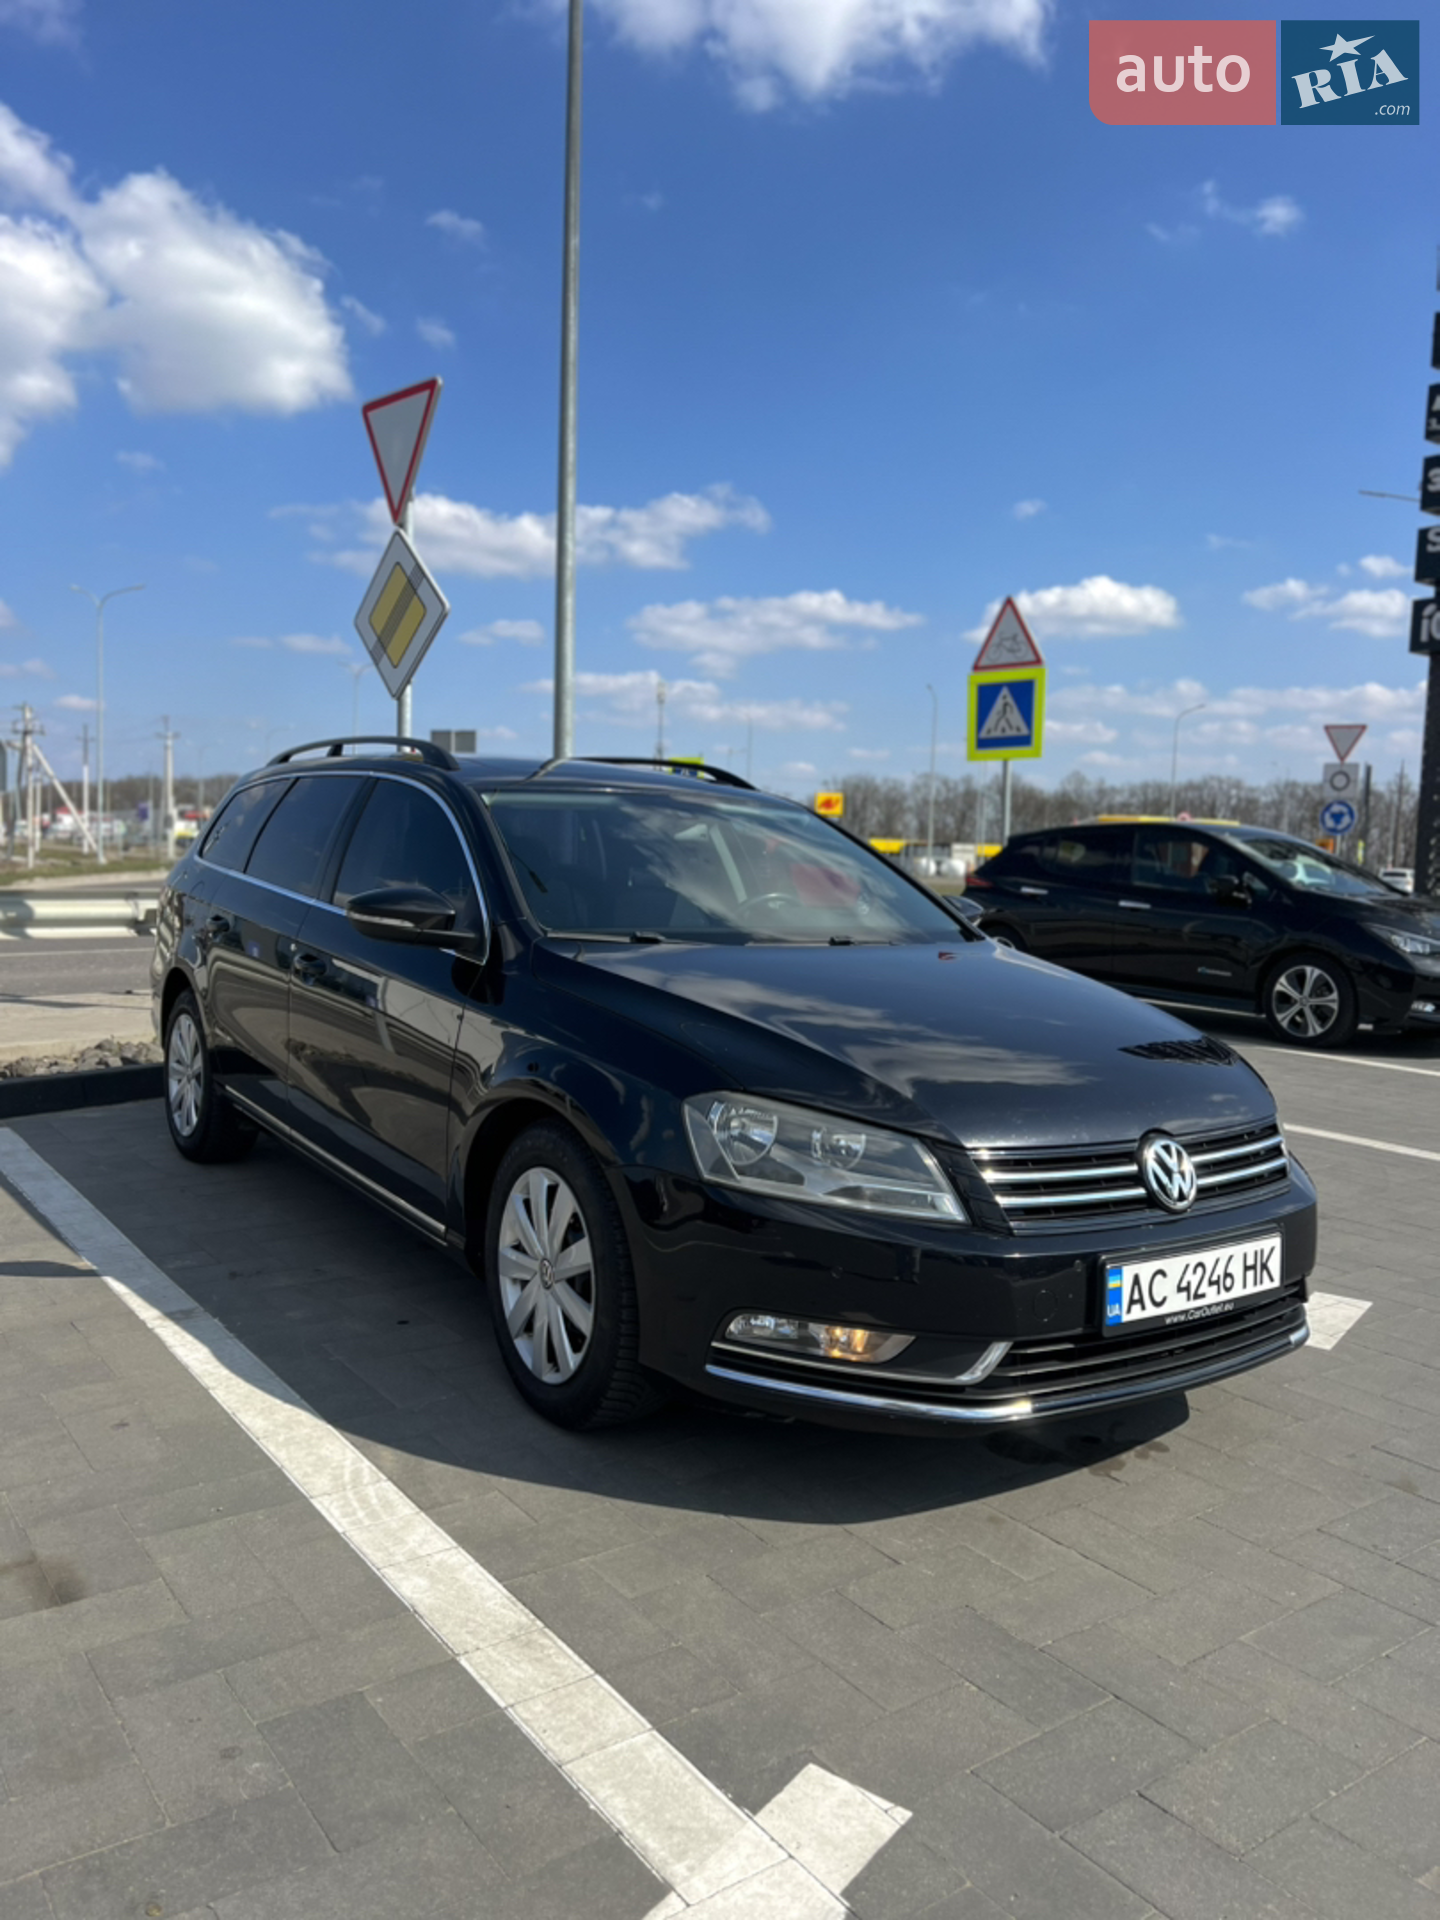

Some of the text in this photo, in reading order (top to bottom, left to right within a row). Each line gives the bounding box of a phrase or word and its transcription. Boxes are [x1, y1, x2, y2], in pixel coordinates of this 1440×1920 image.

[1126, 1245, 1276, 1315] AC 4246 HK
[1107, 1303, 1121, 1317] UA
